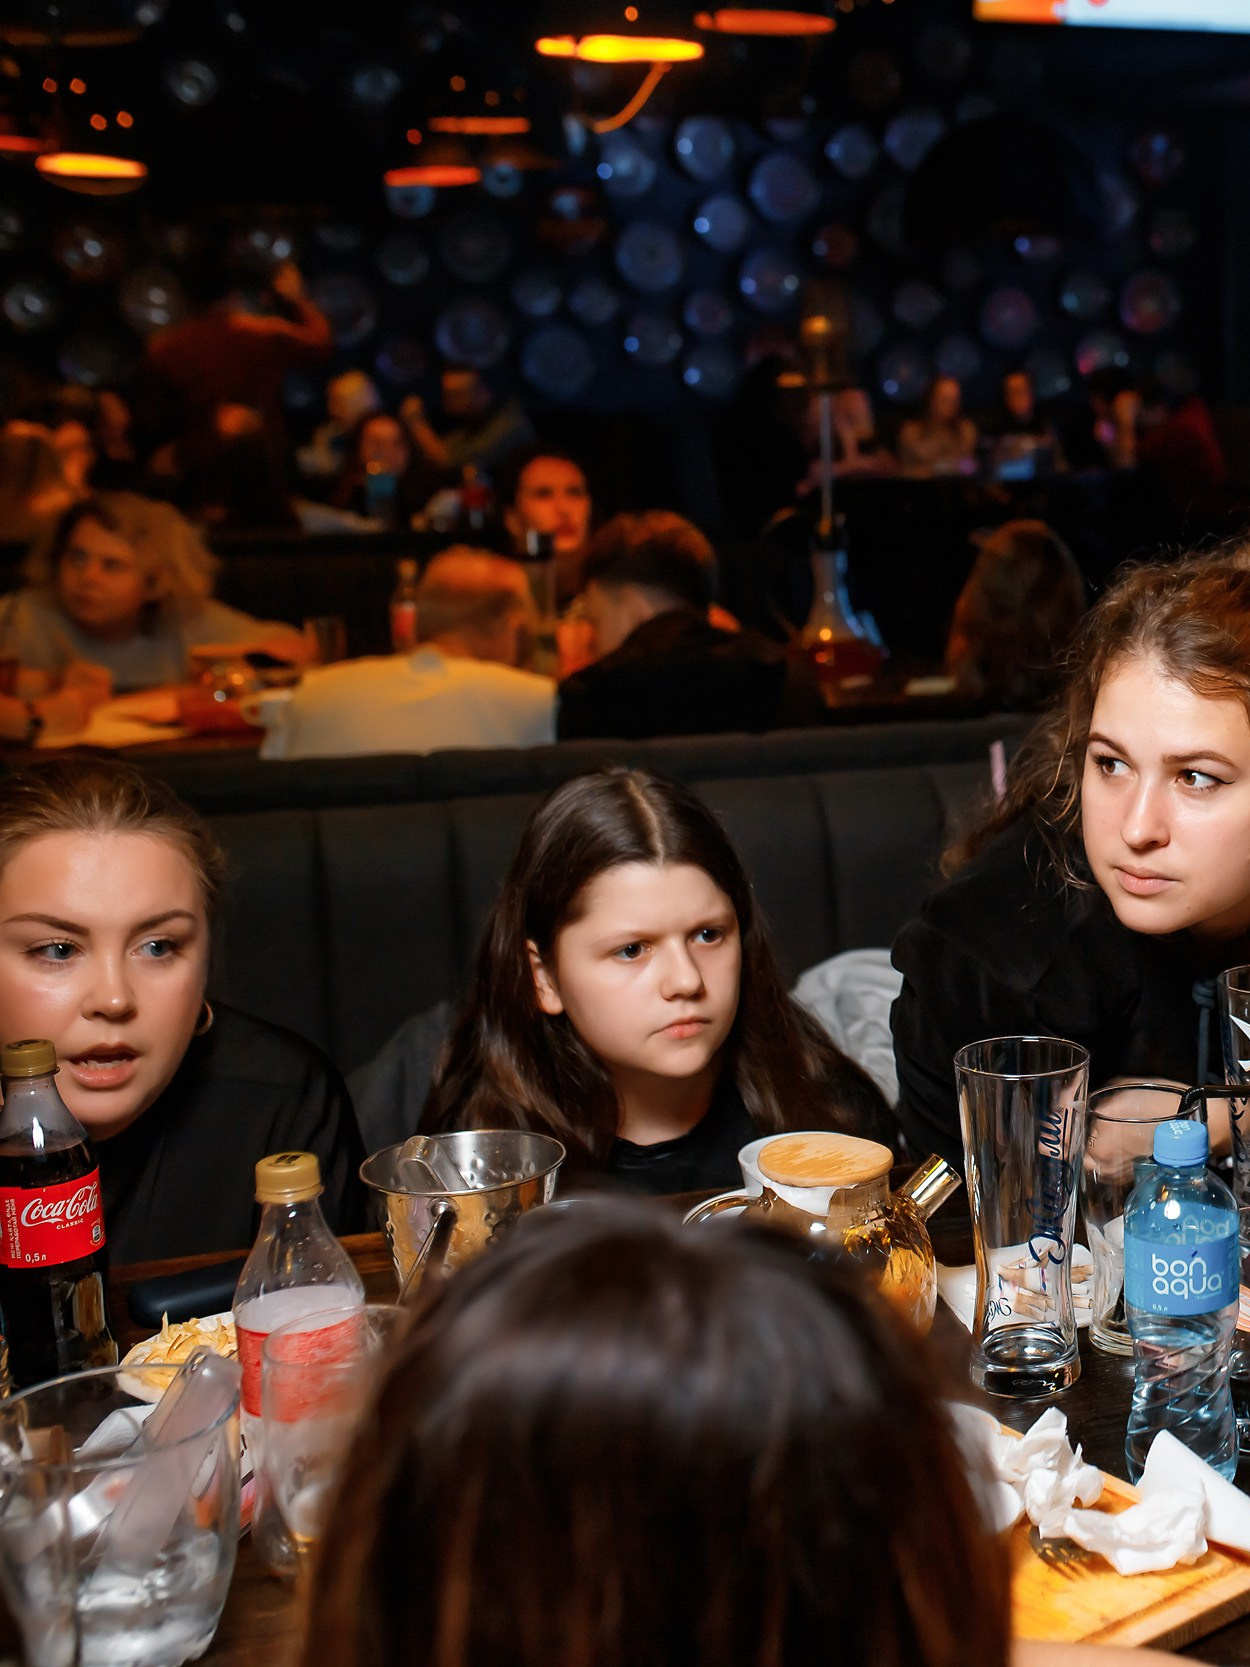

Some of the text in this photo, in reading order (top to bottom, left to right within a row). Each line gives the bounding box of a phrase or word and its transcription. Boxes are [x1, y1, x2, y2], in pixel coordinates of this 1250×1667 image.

[21, 1181, 98, 1228] Coca-Cola
[56, 1218, 84, 1230] CLASSIC
[25, 1253, 40, 1264] 0,5
[1152, 1273, 1222, 1300] aqua
